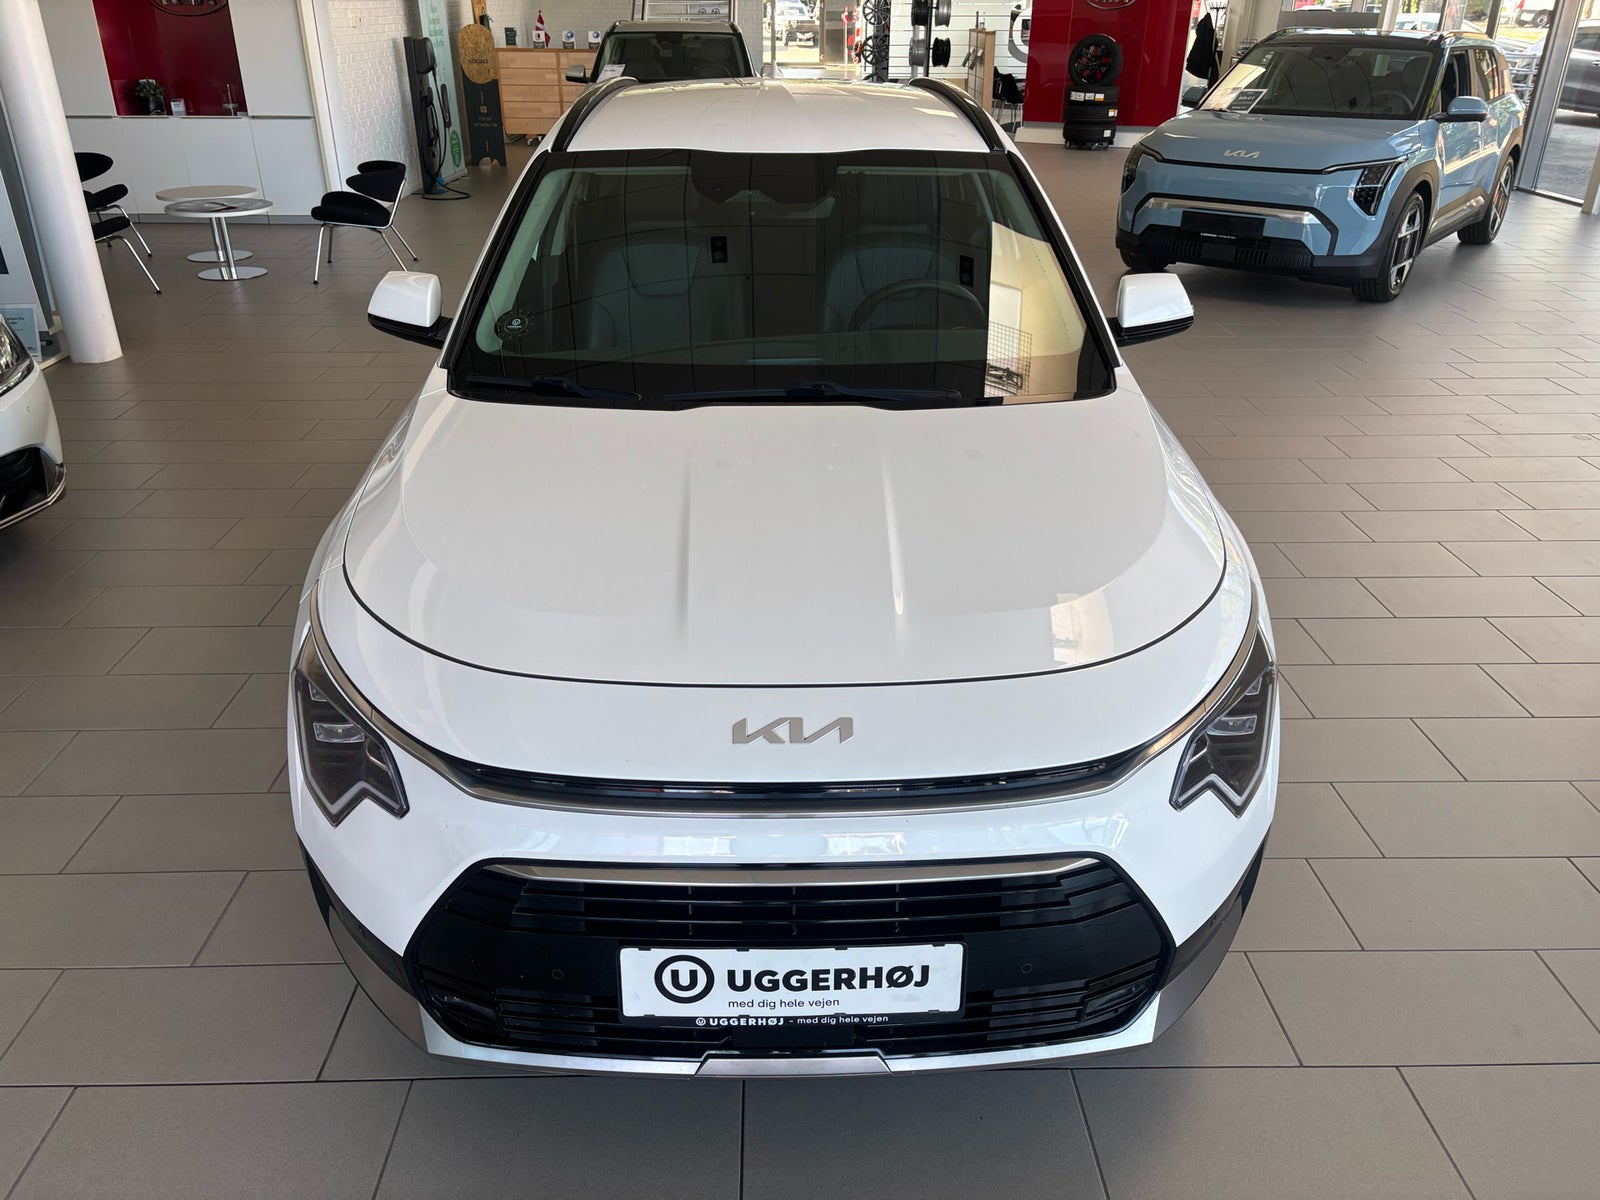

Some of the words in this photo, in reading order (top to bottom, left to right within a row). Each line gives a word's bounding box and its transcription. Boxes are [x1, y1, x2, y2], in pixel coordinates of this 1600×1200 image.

[1223, 149, 1260, 159] KIA
[732, 716, 854, 745] KIA
[727, 964, 930, 993] UGGERHØJ
[728, 999, 754, 1008] med
[757, 999, 776, 1011] dig
[780, 998, 805, 1008] hele
[808, 998, 840, 1009] vejen
[709, 1017, 785, 1026] UGGERHØJ
[821, 1016, 836, 1025] dig
[862, 1015, 889, 1024] vejen
